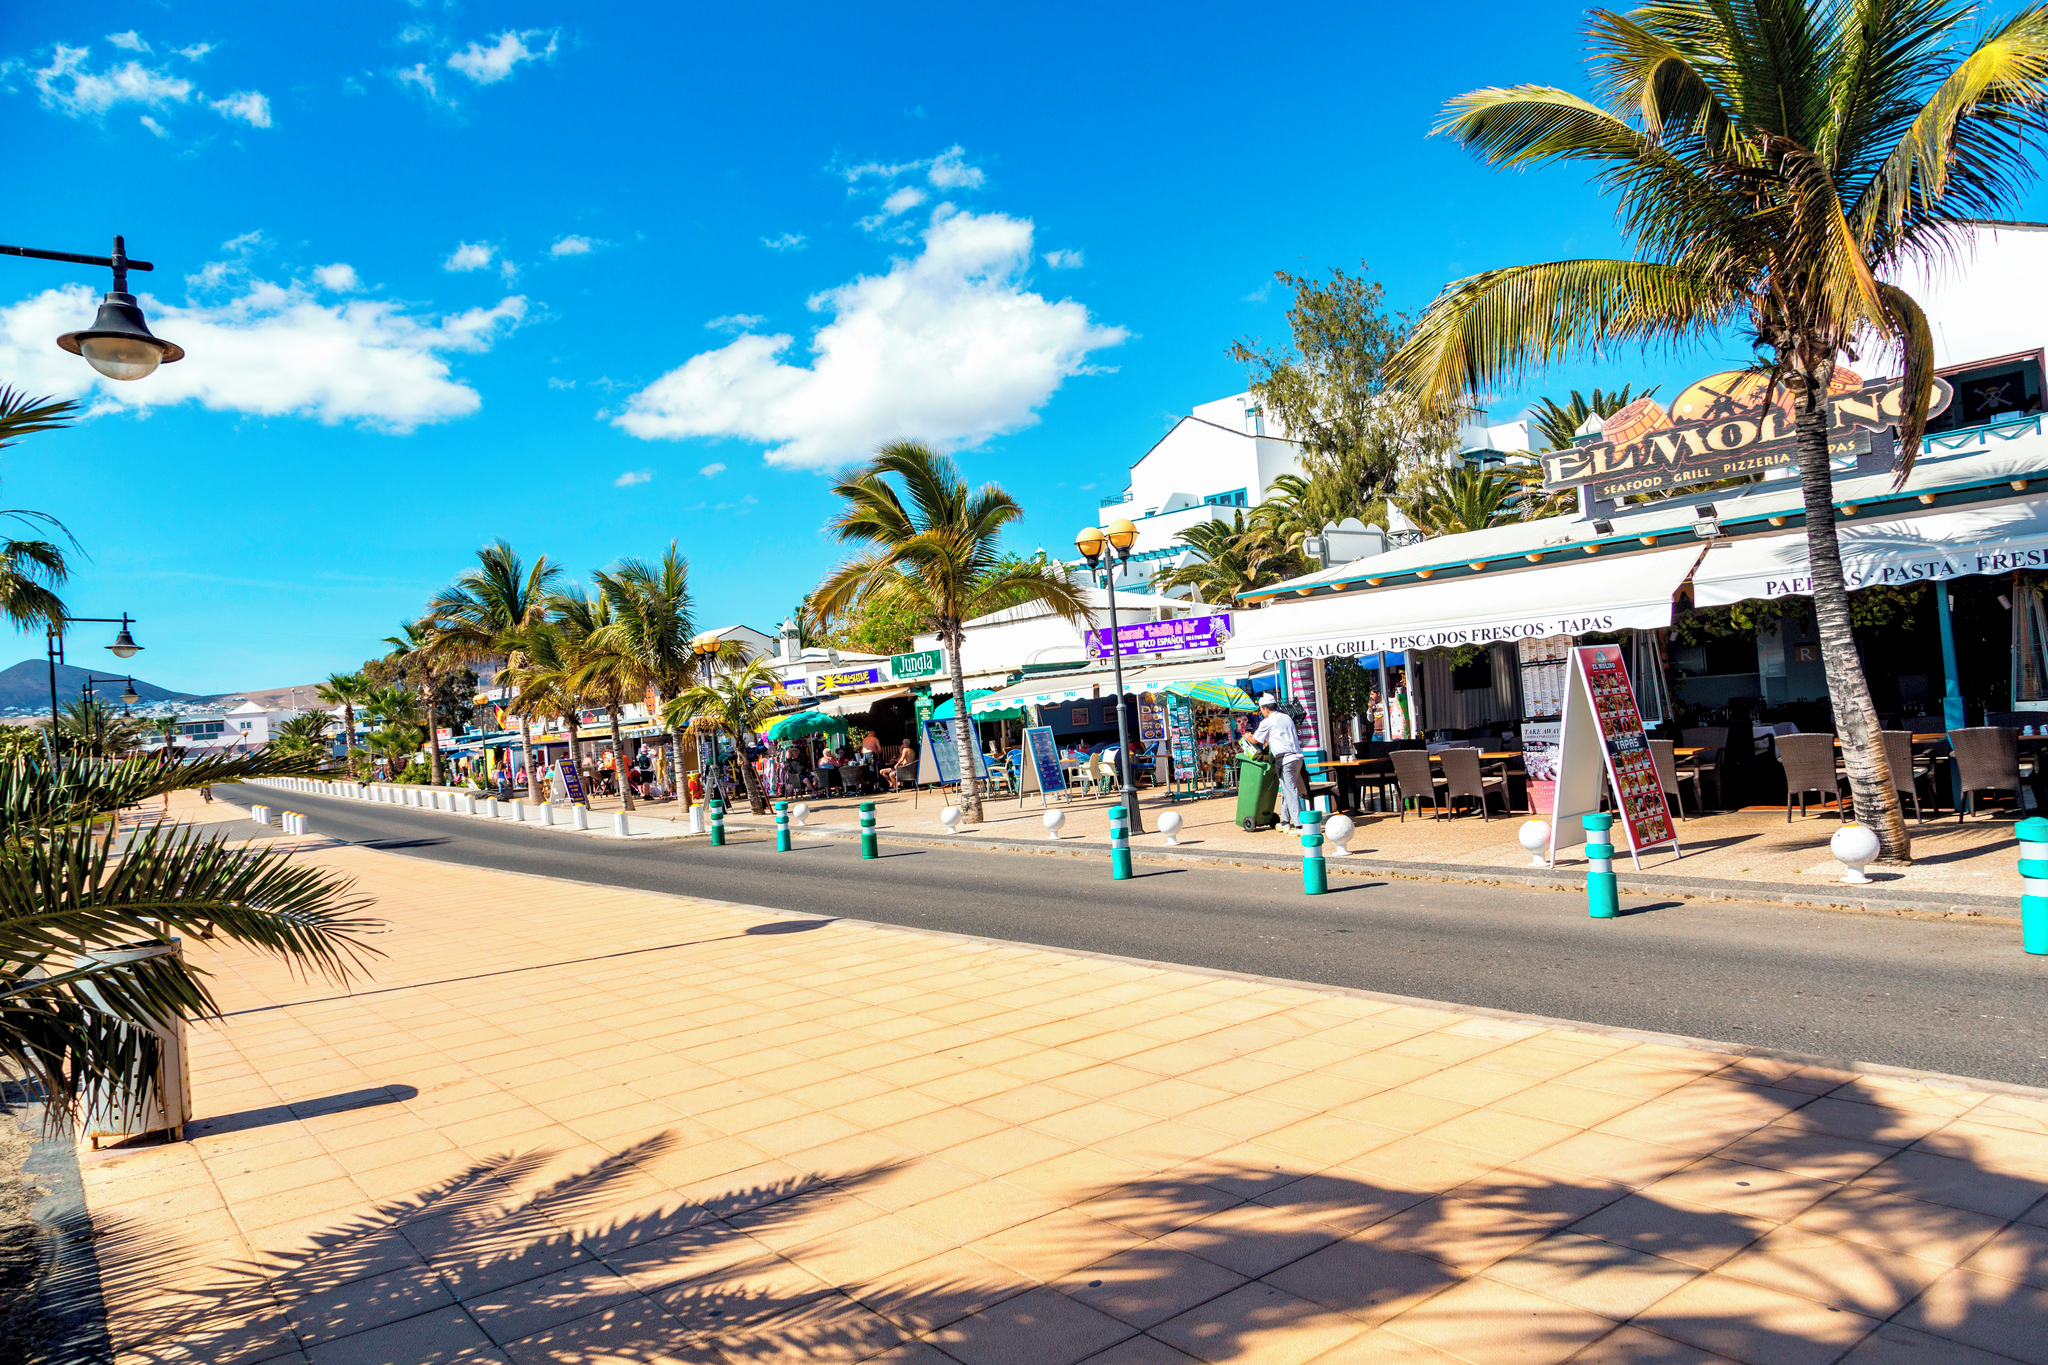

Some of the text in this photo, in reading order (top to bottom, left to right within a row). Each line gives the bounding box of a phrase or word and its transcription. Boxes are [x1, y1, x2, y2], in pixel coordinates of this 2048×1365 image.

[1548, 384, 1943, 484] EL MOLNO
[1603, 476, 1663, 495] SEAFOOD
[1673, 467, 1712, 483] GRILL
[1723, 453, 1791, 473] PIZZERIA
[1765, 571, 1863, 595] PAES
[1882, 561, 1956, 582] PASTA
[1134, 639, 1156, 649] TIPICO
[1156, 635, 1184, 647] ESPAÑOL
[1263, 615, 1613, 661] CARNES AL GRILL PESCADOS FRESCOS TAPAS
[899, 652, 934, 675] Jungla
[1800, 648, 1812, 661] R
[1614, 738, 1640, 751] TAPAS
